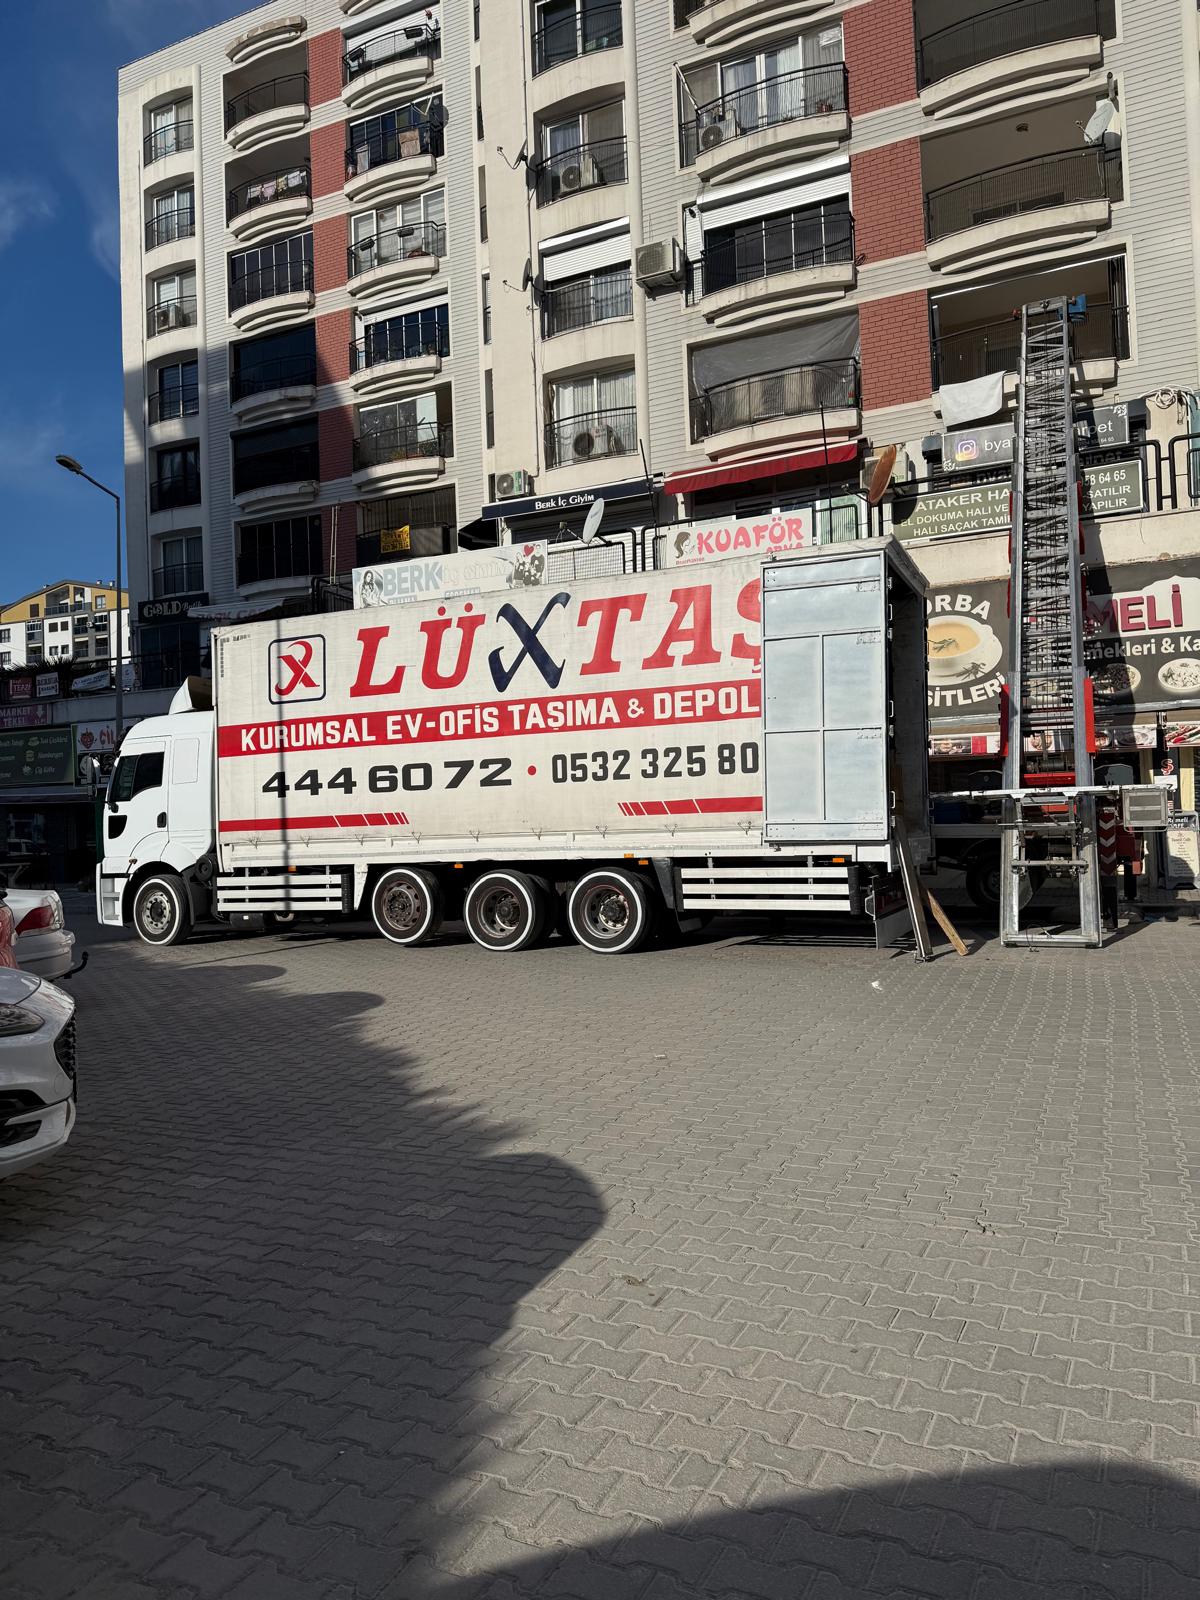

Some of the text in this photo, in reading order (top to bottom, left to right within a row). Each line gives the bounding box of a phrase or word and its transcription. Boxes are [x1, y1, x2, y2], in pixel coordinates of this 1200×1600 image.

[984, 438, 1011, 453] bya
[1099, 471, 1111, 484] 64
[1114, 469, 1126, 482] 65
[915, 488, 1010, 512] ATAKER HA
[1087, 485, 1131, 499] SATILIR
[916, 511, 964, 525] DOKUMA
[966, 506, 991, 517] HALI
[994, 503, 1009, 513] VE
[1082, 498, 1128, 512] YAPILIR
[696, 516, 804, 555] KUAFÖR
[913, 526, 938, 537] HALI
[941, 519, 978, 533] SAÇAK
[382, 561, 440, 597] BERK
[143, 600, 182, 618] GOLD
[1086, 583, 1183, 633] MELİ
[1087, 635, 1200, 659] mekleri & Ka
[241, 685, 760, 752] KURUMSAL EV-OFİS TAŞIMA & DEPOL
[551, 749, 631, 784] 0532
[641, 744, 706, 779] 325
[717, 741, 759, 775] 80
